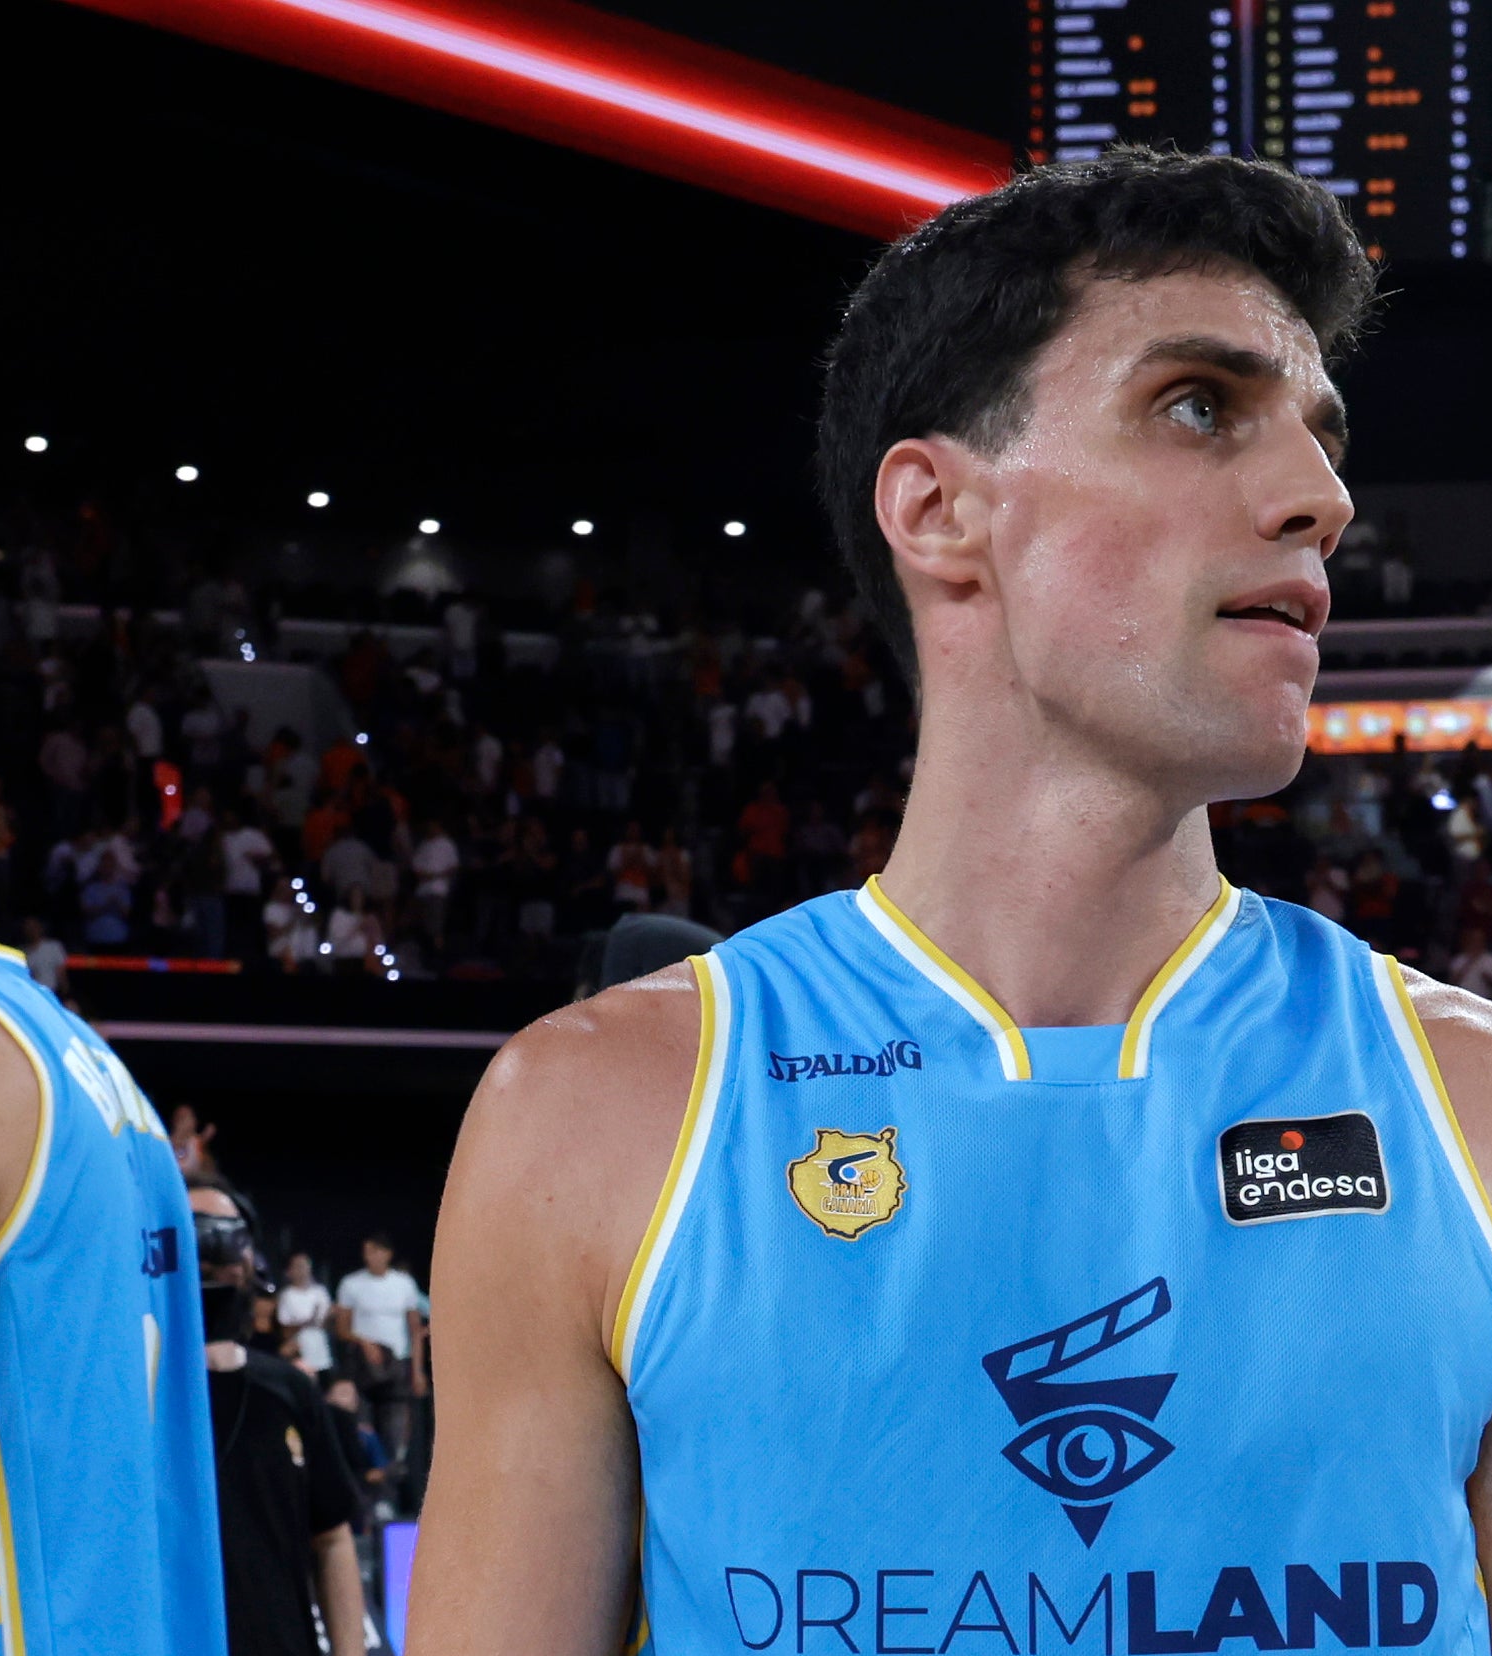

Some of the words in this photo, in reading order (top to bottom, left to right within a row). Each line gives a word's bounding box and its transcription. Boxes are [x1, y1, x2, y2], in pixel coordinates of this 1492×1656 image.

[768, 1039, 922, 1082] SPALDING
[1235, 1149, 1299, 1179] liga
[831, 1183, 866, 1199] GRAN
[1239, 1173, 1378, 1206] endesa
[821, 1197, 878, 1216] CANARIA
[724, 1560, 1439, 1656] DREAMLAND
